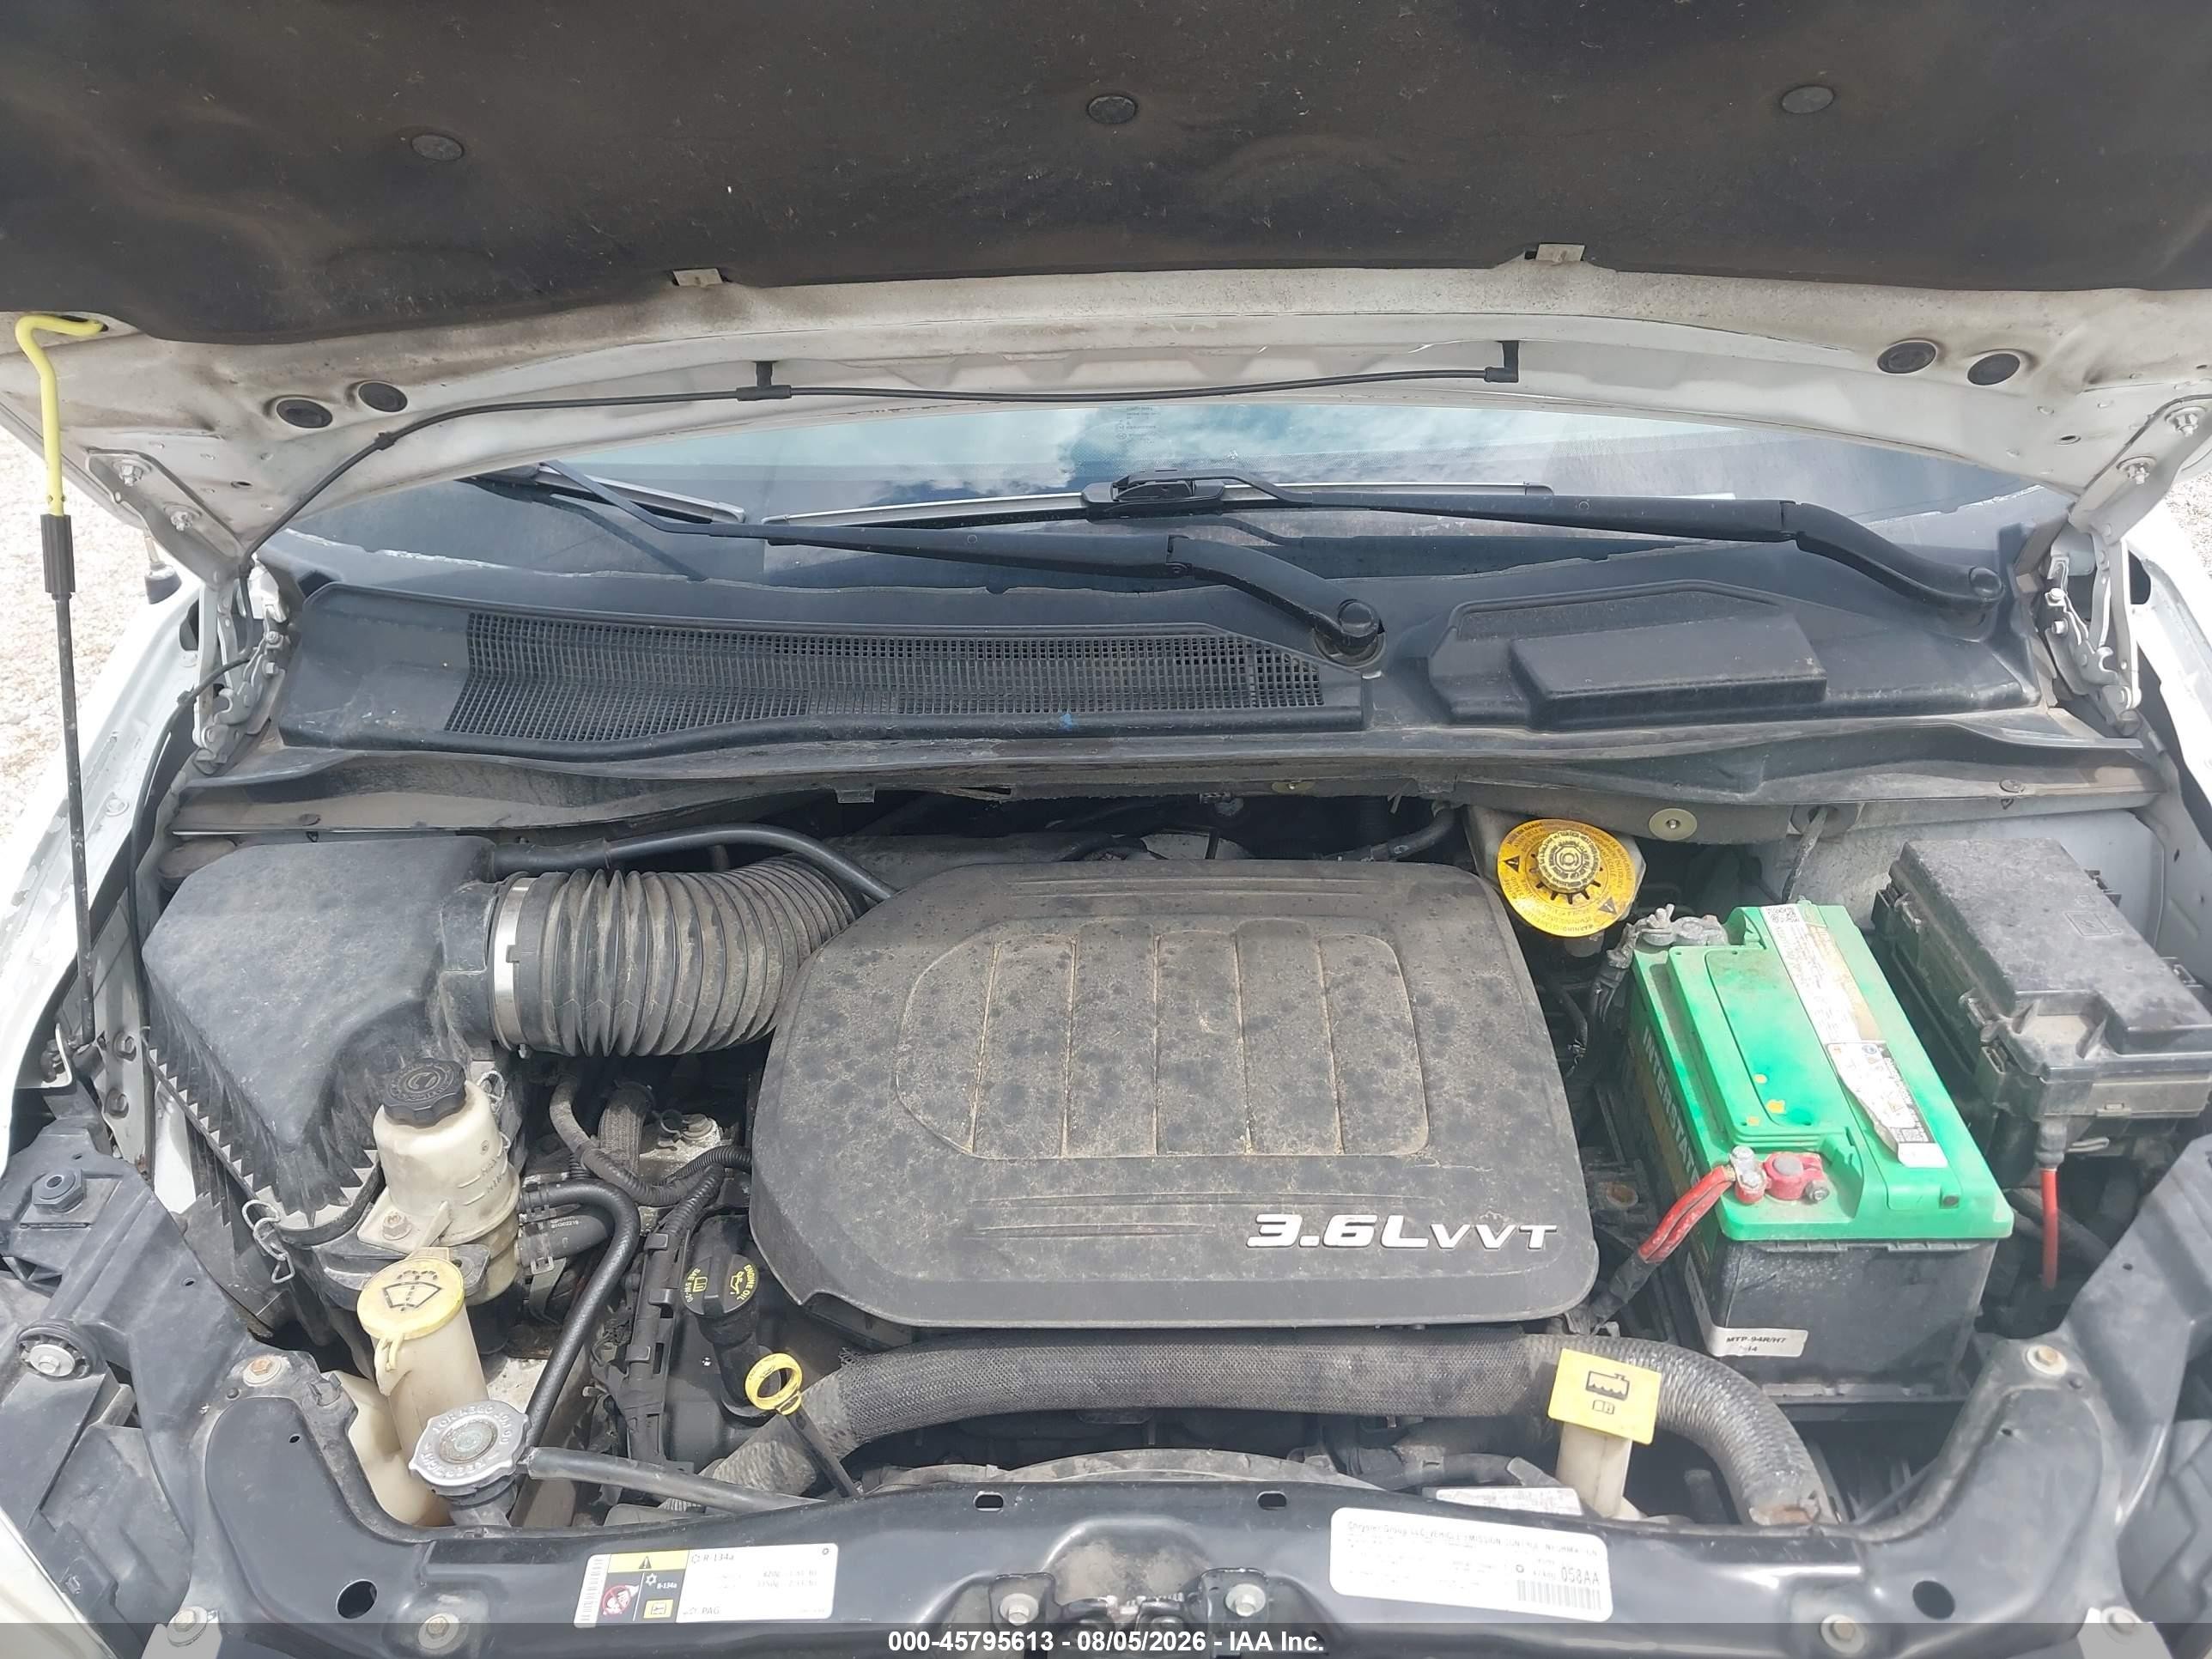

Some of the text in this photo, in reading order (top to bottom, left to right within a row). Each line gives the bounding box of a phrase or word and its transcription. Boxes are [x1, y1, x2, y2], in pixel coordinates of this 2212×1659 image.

[687, 1267, 702, 1281] SAE
[736, 1263, 757, 1301] ENGINE OIL
[1726, 1335, 1787, 1344] MTP-94R/H7
[1560, 1565, 1601, 1585] 058AA
